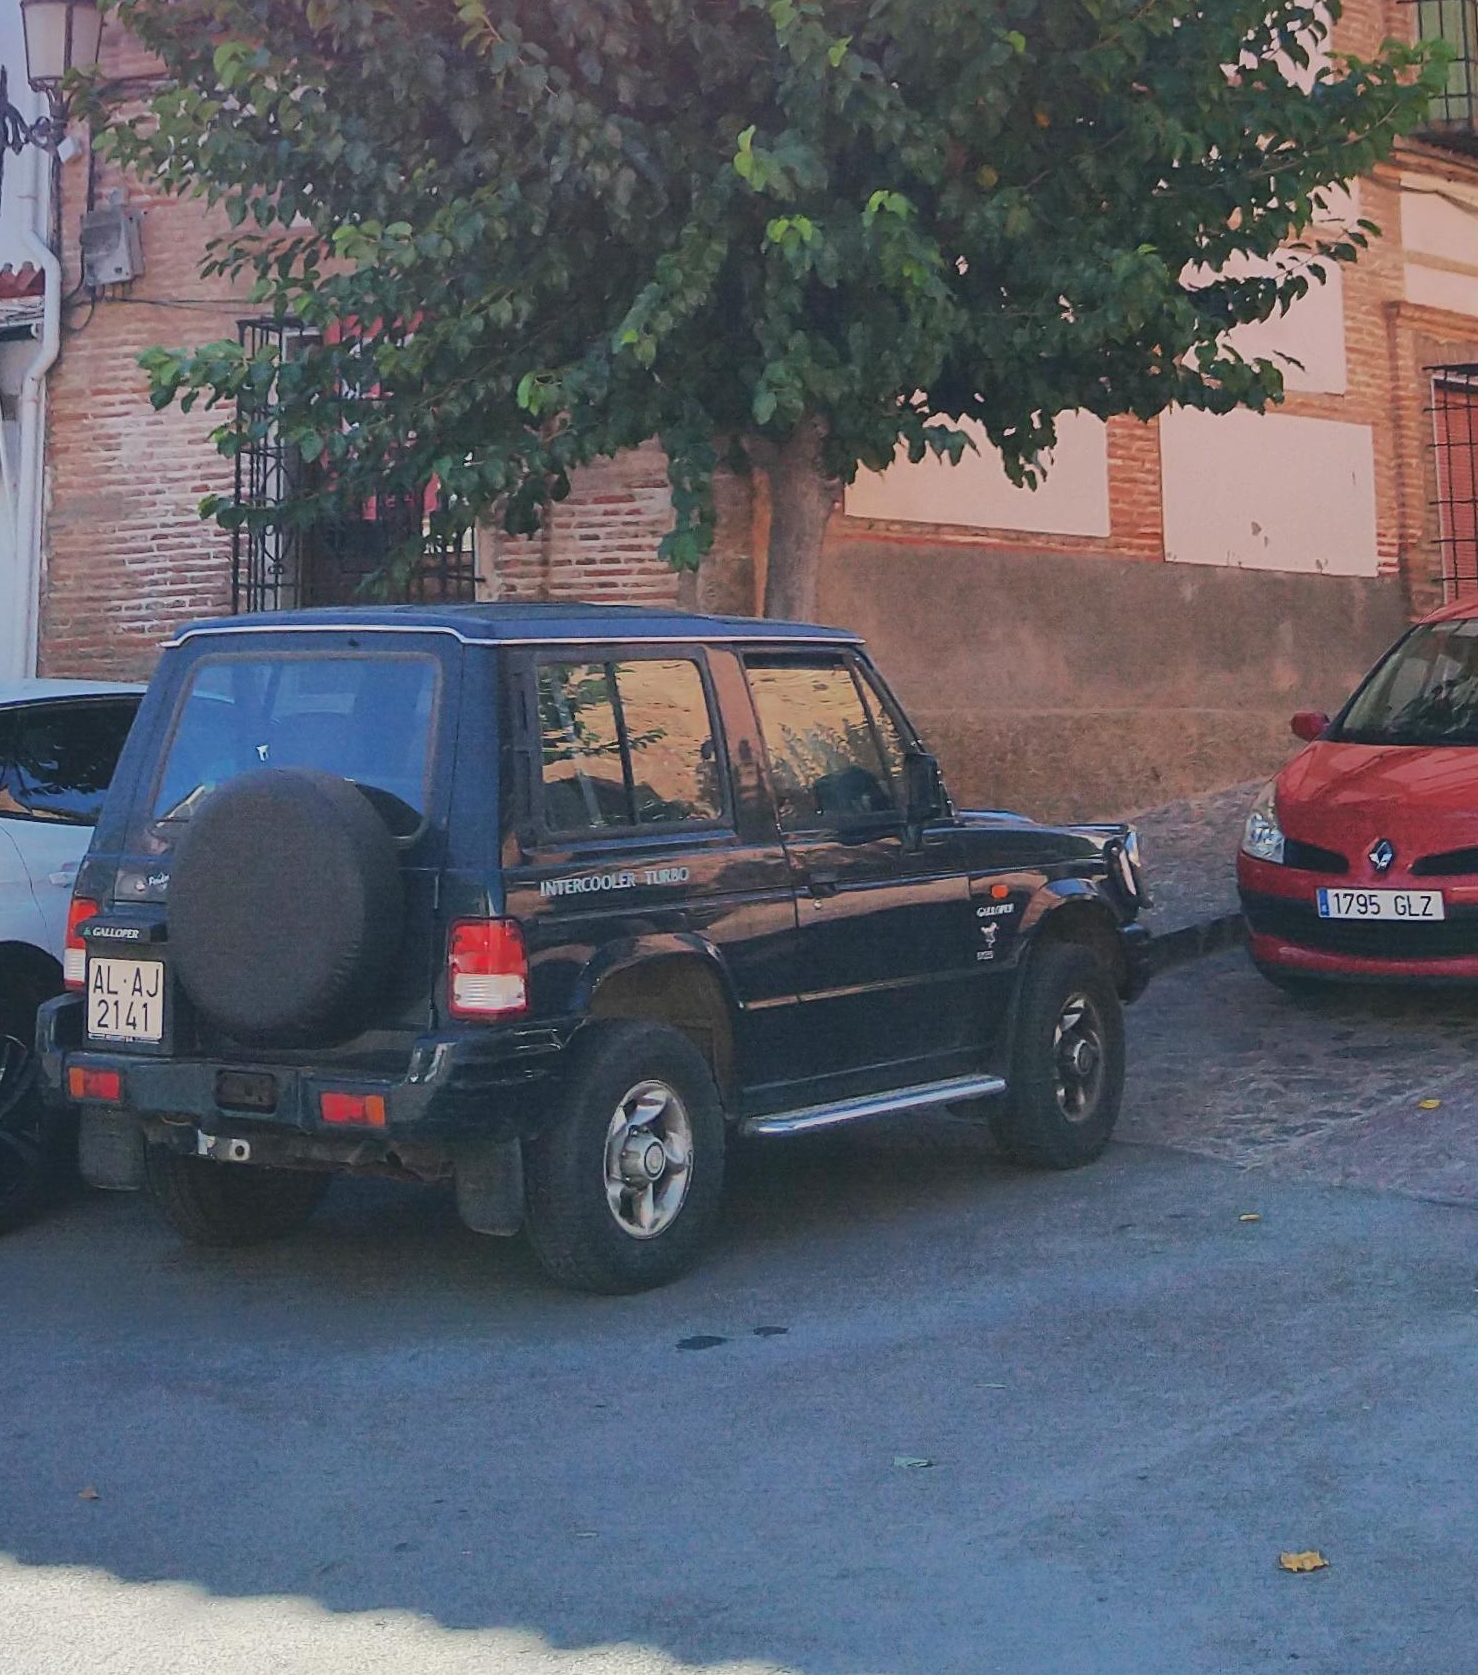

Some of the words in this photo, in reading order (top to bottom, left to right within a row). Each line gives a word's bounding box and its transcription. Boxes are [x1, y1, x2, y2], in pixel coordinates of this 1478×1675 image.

[539, 872, 636, 897] INTERCOOLER
[644, 867, 690, 886] TURBO
[1333, 893, 1381, 915] 1795
[1393, 895, 1434, 917] GLZ
[92, 926, 140, 940] GALLOPER
[96, 999, 149, 1032] 2141
